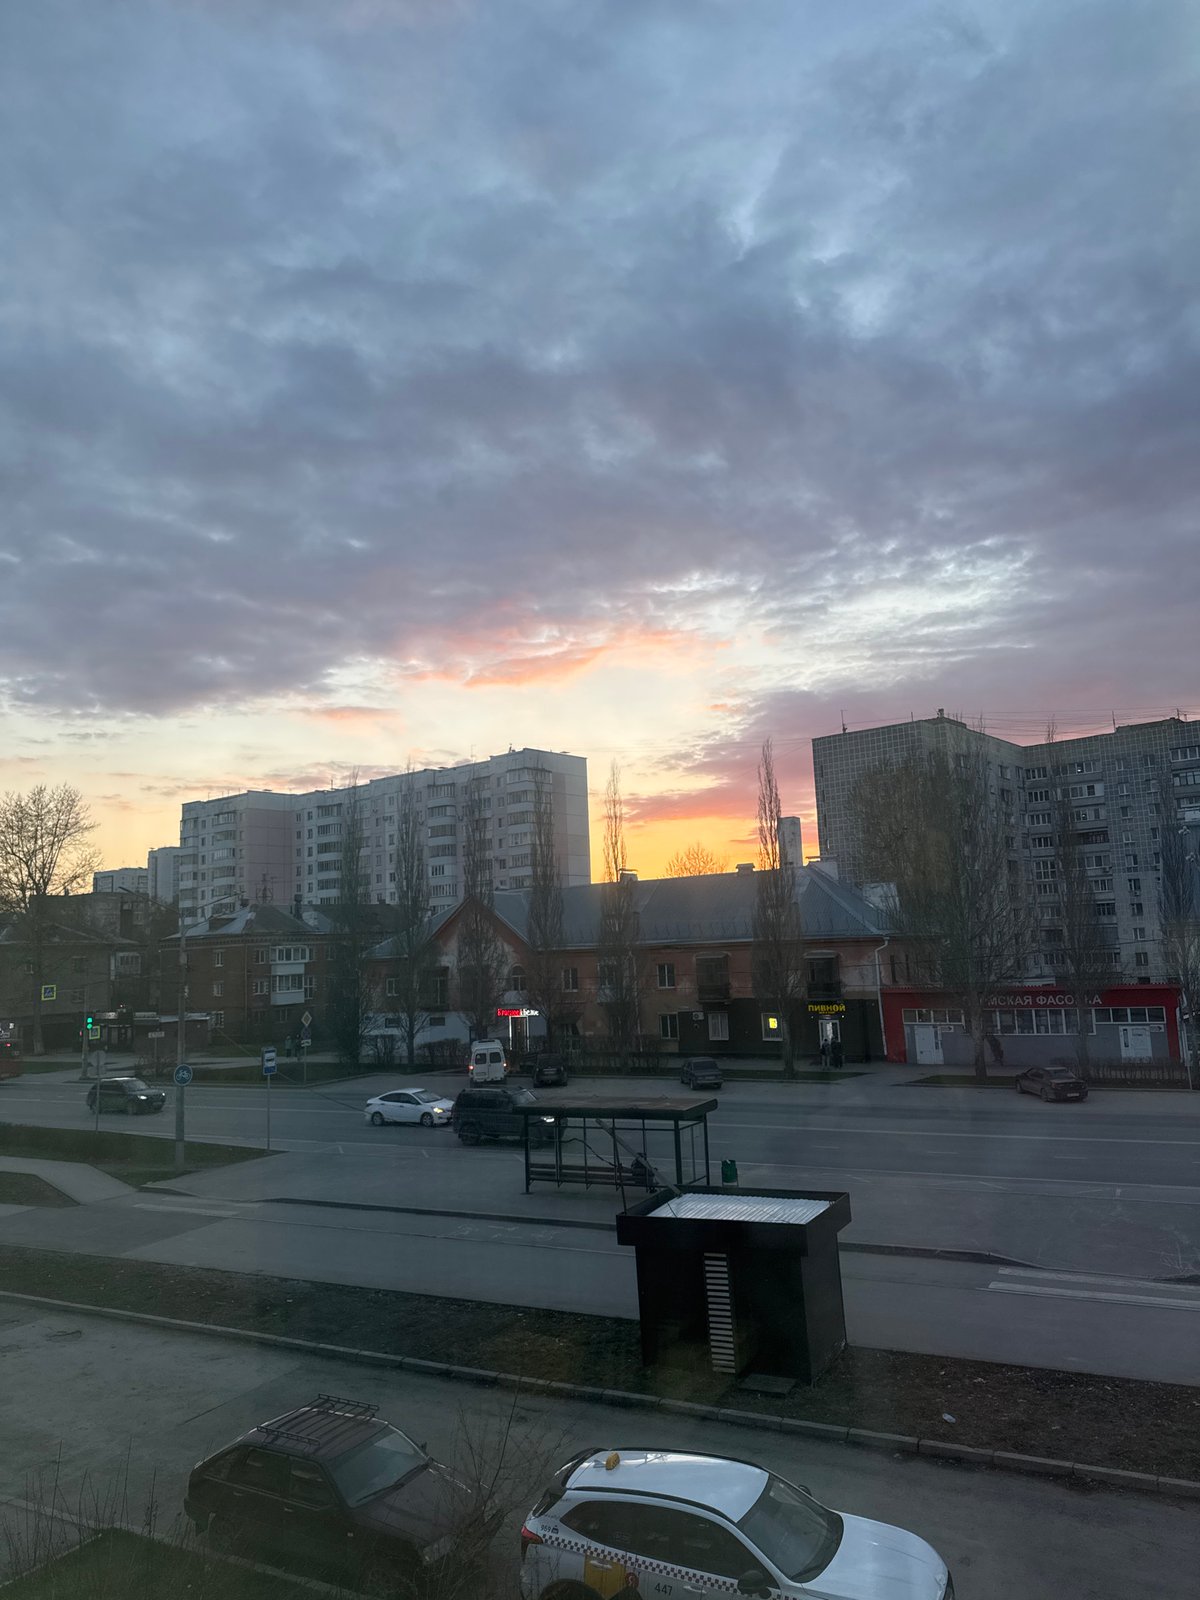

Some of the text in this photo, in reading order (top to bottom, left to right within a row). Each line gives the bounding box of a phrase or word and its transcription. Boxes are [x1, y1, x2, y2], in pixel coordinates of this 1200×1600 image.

[1036, 994, 1102, 1005] ФАСОА
[808, 1003, 846, 1012] ПИВНОЙ
[655, 1582, 673, 1596] 447
